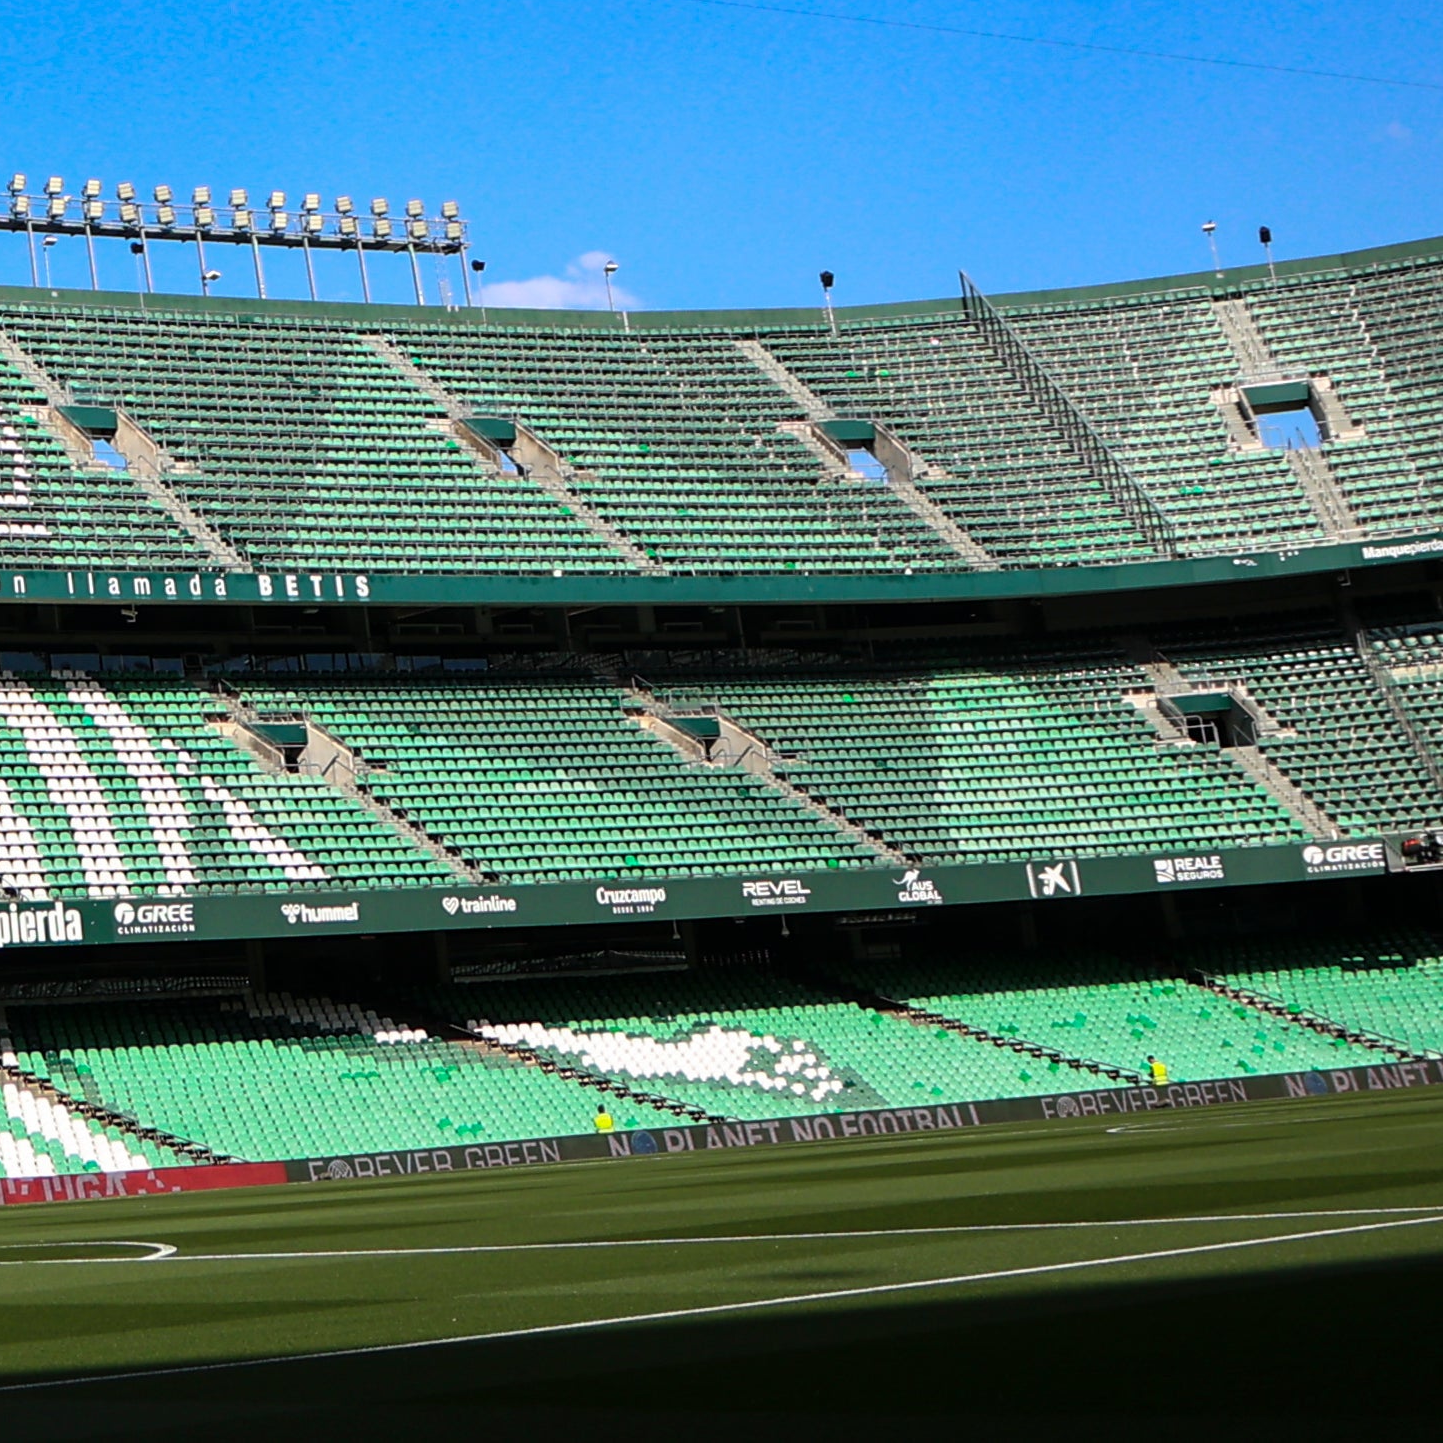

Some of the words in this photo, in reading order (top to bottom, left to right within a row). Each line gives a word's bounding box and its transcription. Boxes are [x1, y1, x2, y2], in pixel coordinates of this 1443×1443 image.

[67, 572, 227, 596] llamada
[259, 575, 369, 597] BETIS
[1326, 843, 1383, 862] GREE
[1176, 856, 1221, 870] REALE
[1177, 870, 1224, 881] SEGUROS
[742, 880, 811, 897] REVEL
[912, 880, 933, 890] AUS
[596, 887, 666, 904] Cruzcampo
[898, 890, 942, 901] GLOBAL
[137, 904, 193, 922] GREE
[301, 903, 359, 922] hummel
[461, 896, 516, 913] trainline
